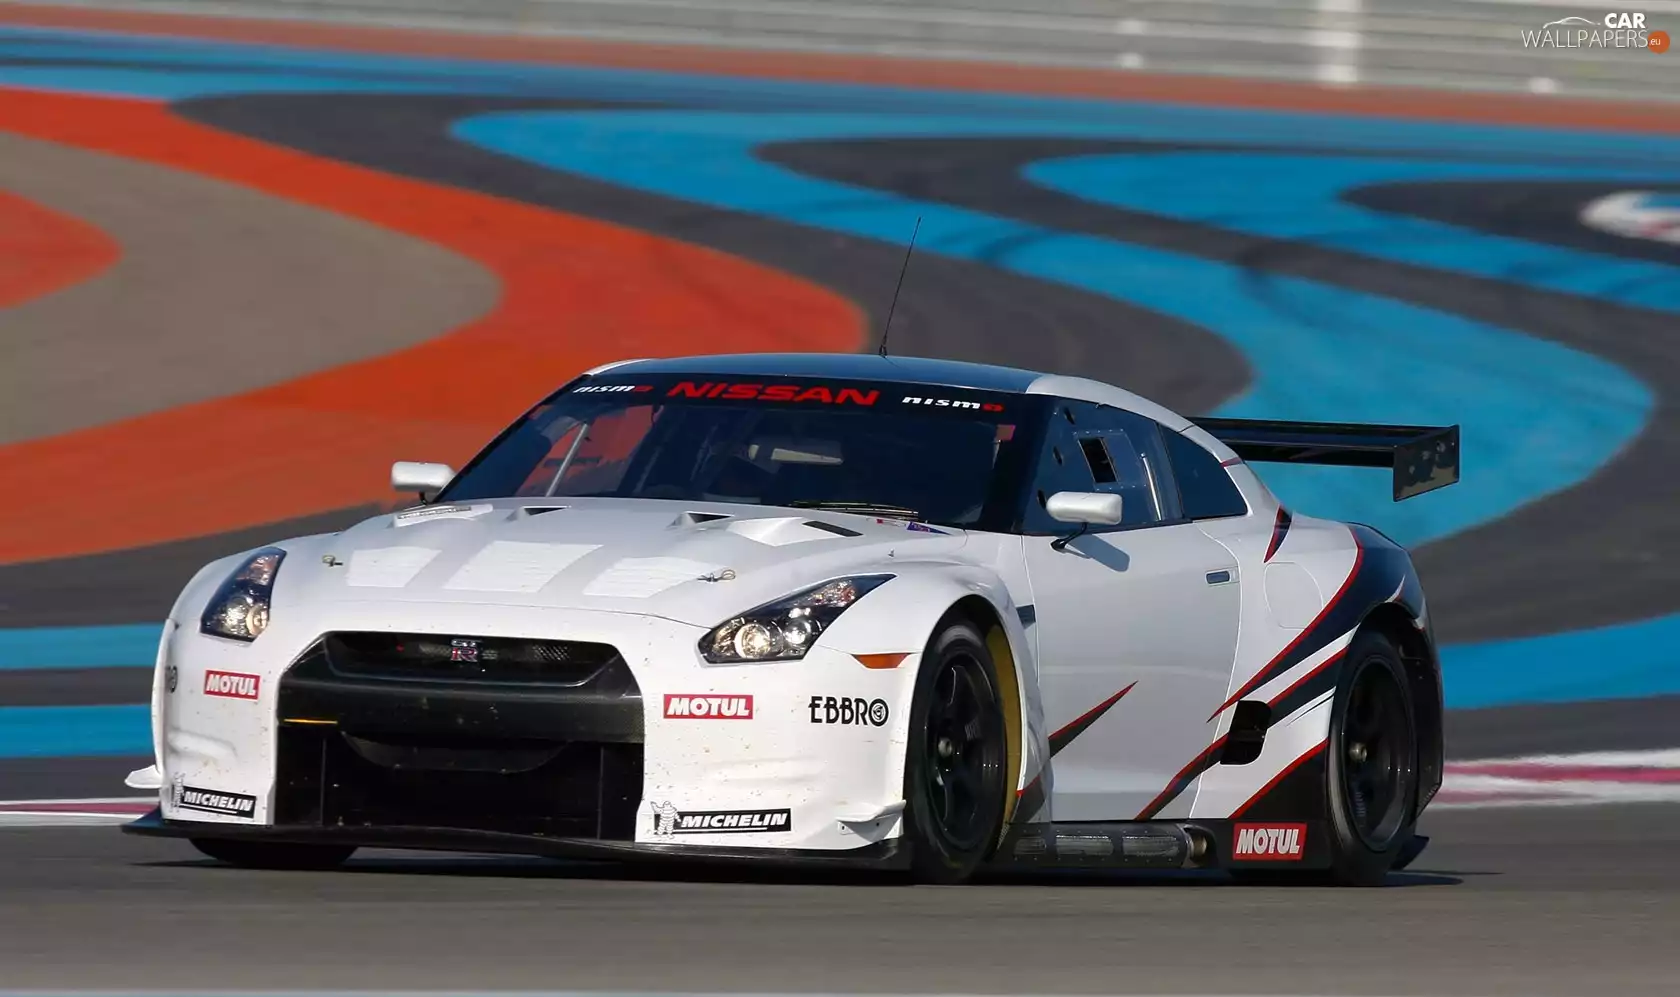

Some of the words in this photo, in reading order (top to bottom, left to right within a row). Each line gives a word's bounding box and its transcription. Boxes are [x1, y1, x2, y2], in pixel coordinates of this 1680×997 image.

[667, 382, 880, 405] NISSAN
[206, 673, 257, 696] MOTUL
[667, 698, 750, 716] MOTUL
[808, 696, 889, 727] EBBRO
[184, 790, 254, 812] MICHELIN
[681, 812, 788, 828] MICHELIN
[1236, 828, 1300, 854] MOTUL
